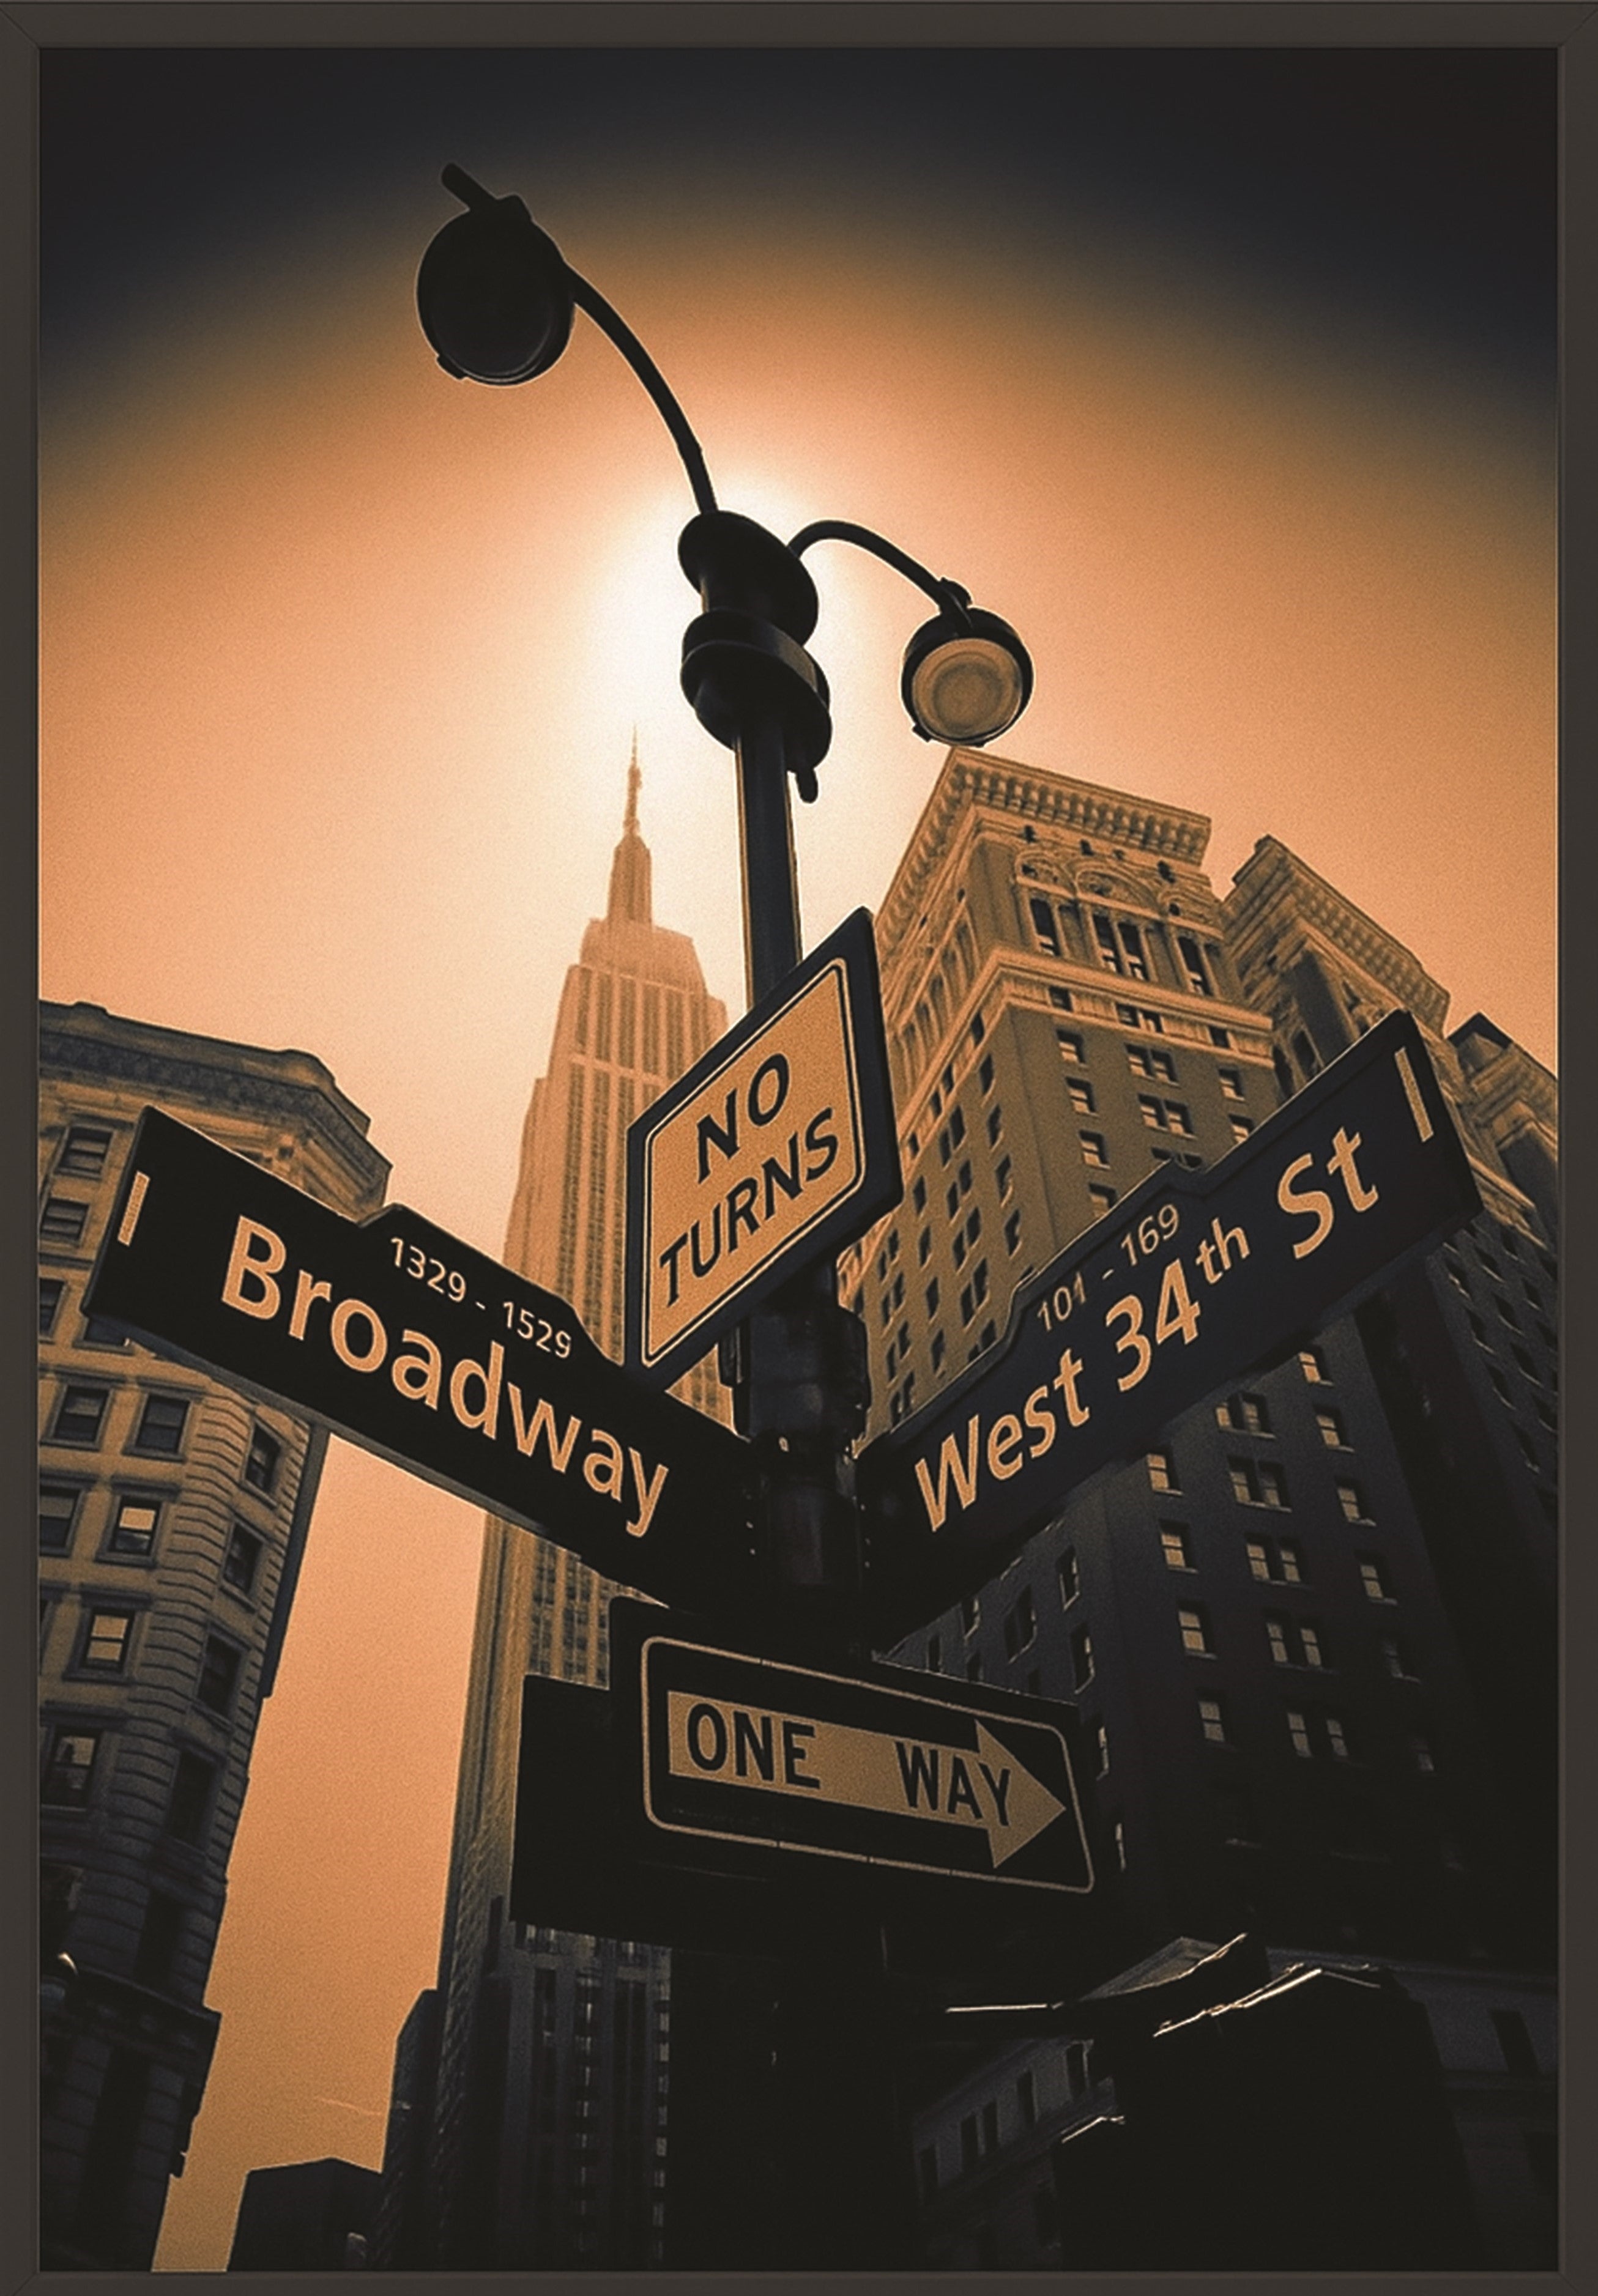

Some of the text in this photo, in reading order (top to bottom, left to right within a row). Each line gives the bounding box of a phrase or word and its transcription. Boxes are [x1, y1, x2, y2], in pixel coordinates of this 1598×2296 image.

[697, 1053, 790, 1185] NO
[660, 1107, 838, 1308] TURNS
[1037, 1271, 1086, 1331] 101
[1121, 1204, 1179, 1265] 169
[390, 1237, 467, 1303] 1329
[502, 1300, 572, 1359] 1529
[915, 1126, 1379, 1533] West 34th St
[221, 1215, 669, 1538] Broadway
[686, 1703, 1011, 1827] ONE WAY
